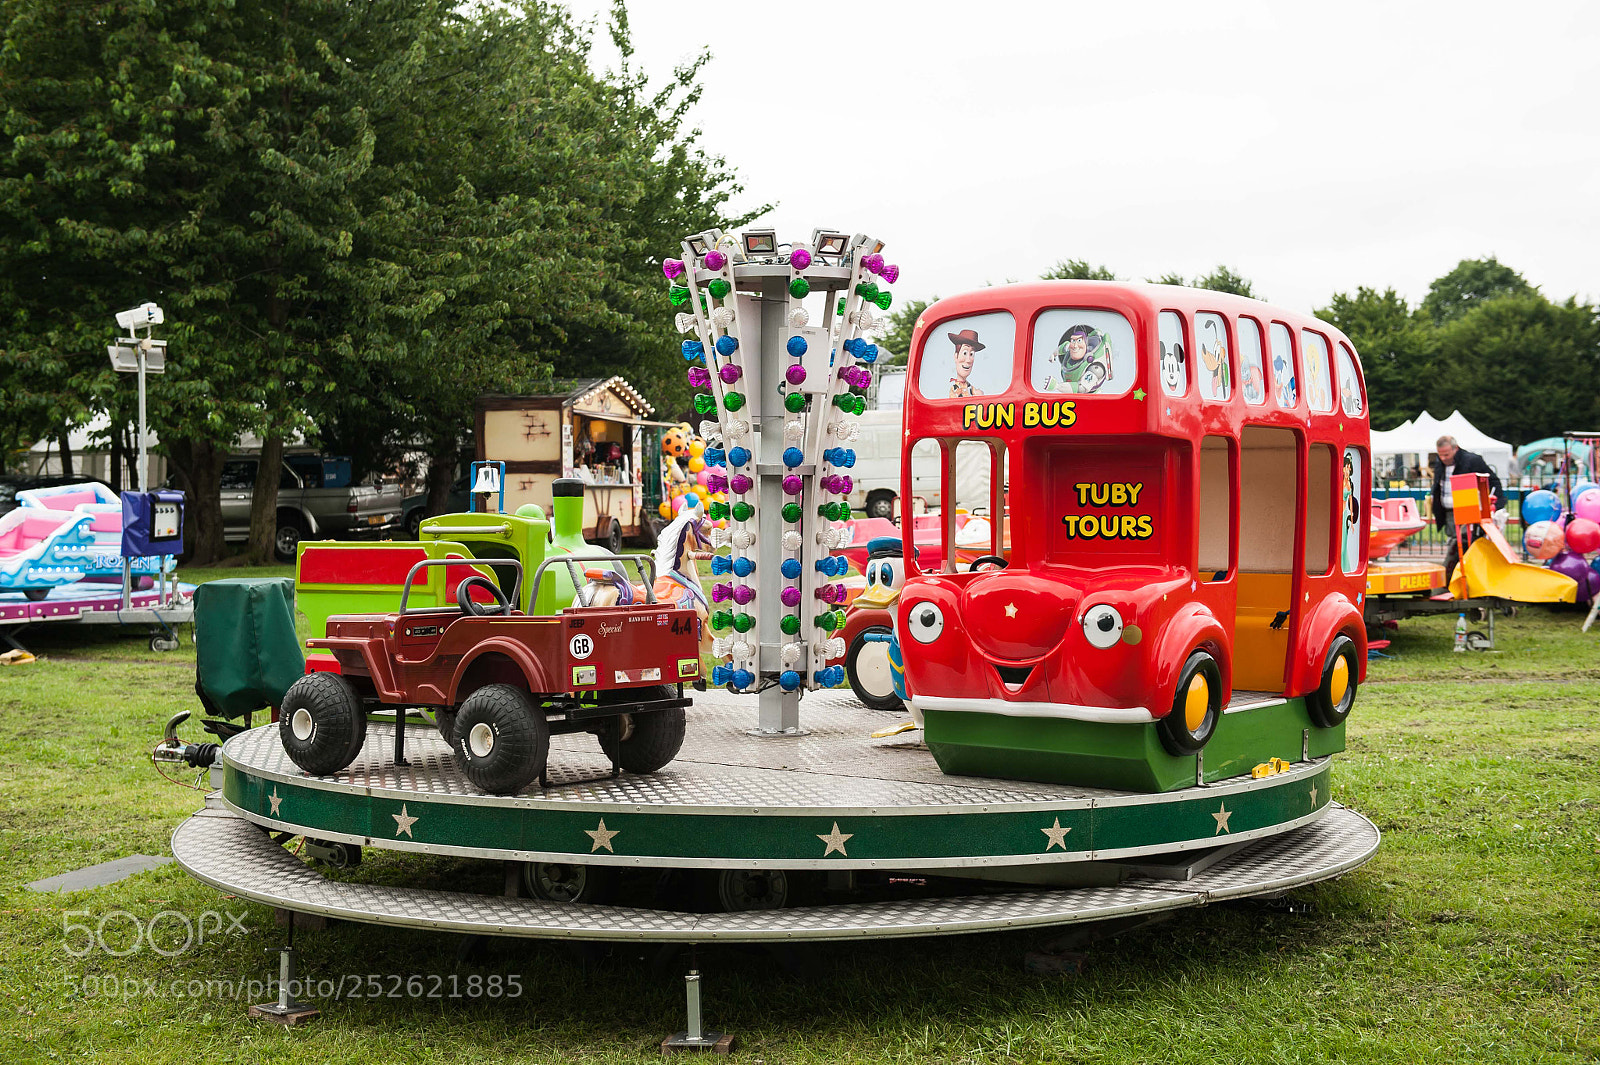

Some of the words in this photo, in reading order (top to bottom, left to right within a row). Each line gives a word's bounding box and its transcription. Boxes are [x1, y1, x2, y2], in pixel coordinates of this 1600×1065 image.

[963, 403, 1015, 430] FUN
[1023, 401, 1077, 429] BUS
[1073, 482, 1144, 508] TUBY
[1062, 515, 1153, 540] TOURS
[1400, 574, 1431, 590] PLEASE
[598, 621, 623, 637] Special
[574, 639, 589, 655] GB
